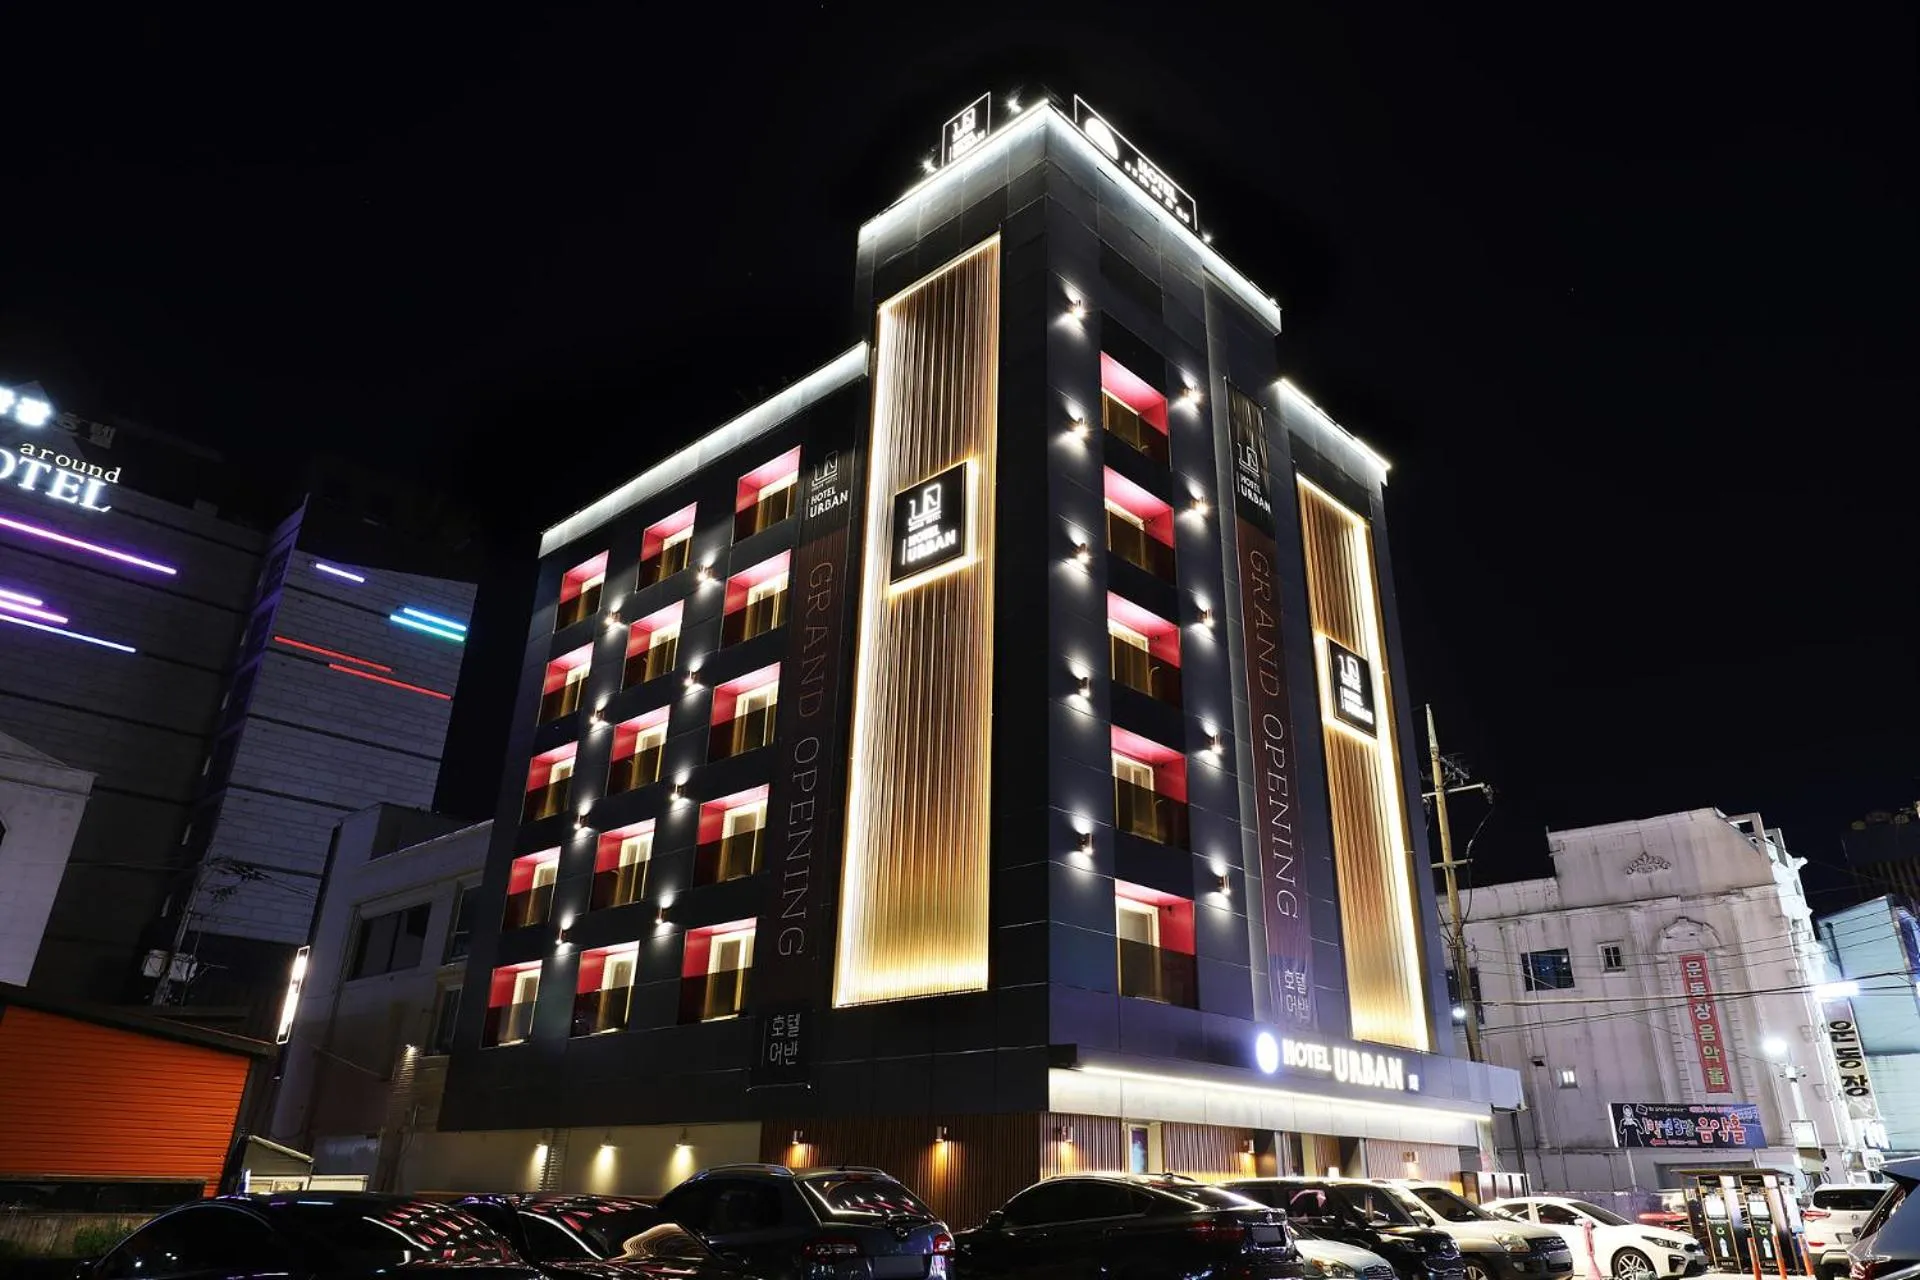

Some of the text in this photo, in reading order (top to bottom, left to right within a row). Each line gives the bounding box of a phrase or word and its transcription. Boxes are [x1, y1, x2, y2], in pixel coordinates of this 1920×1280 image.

[20, 442, 121, 483] around
[809, 490, 848, 518] URBAN
[811, 487, 835, 504] HOTEL
[1240, 484, 1271, 514] URBAN
[907, 529, 956, 562] URBAN
[1250, 550, 1299, 919] GRAND OPENING
[778, 562, 833, 956] GRAND OPENING
[771, 1013, 801, 1037] 호텔
[770, 1040, 798, 1066] 어반
[1282, 1037, 1332, 1072] HOTEL
[1332, 1047, 1404, 1091] URBAN
[1696, 1112, 1747, 1145] 음악홀
